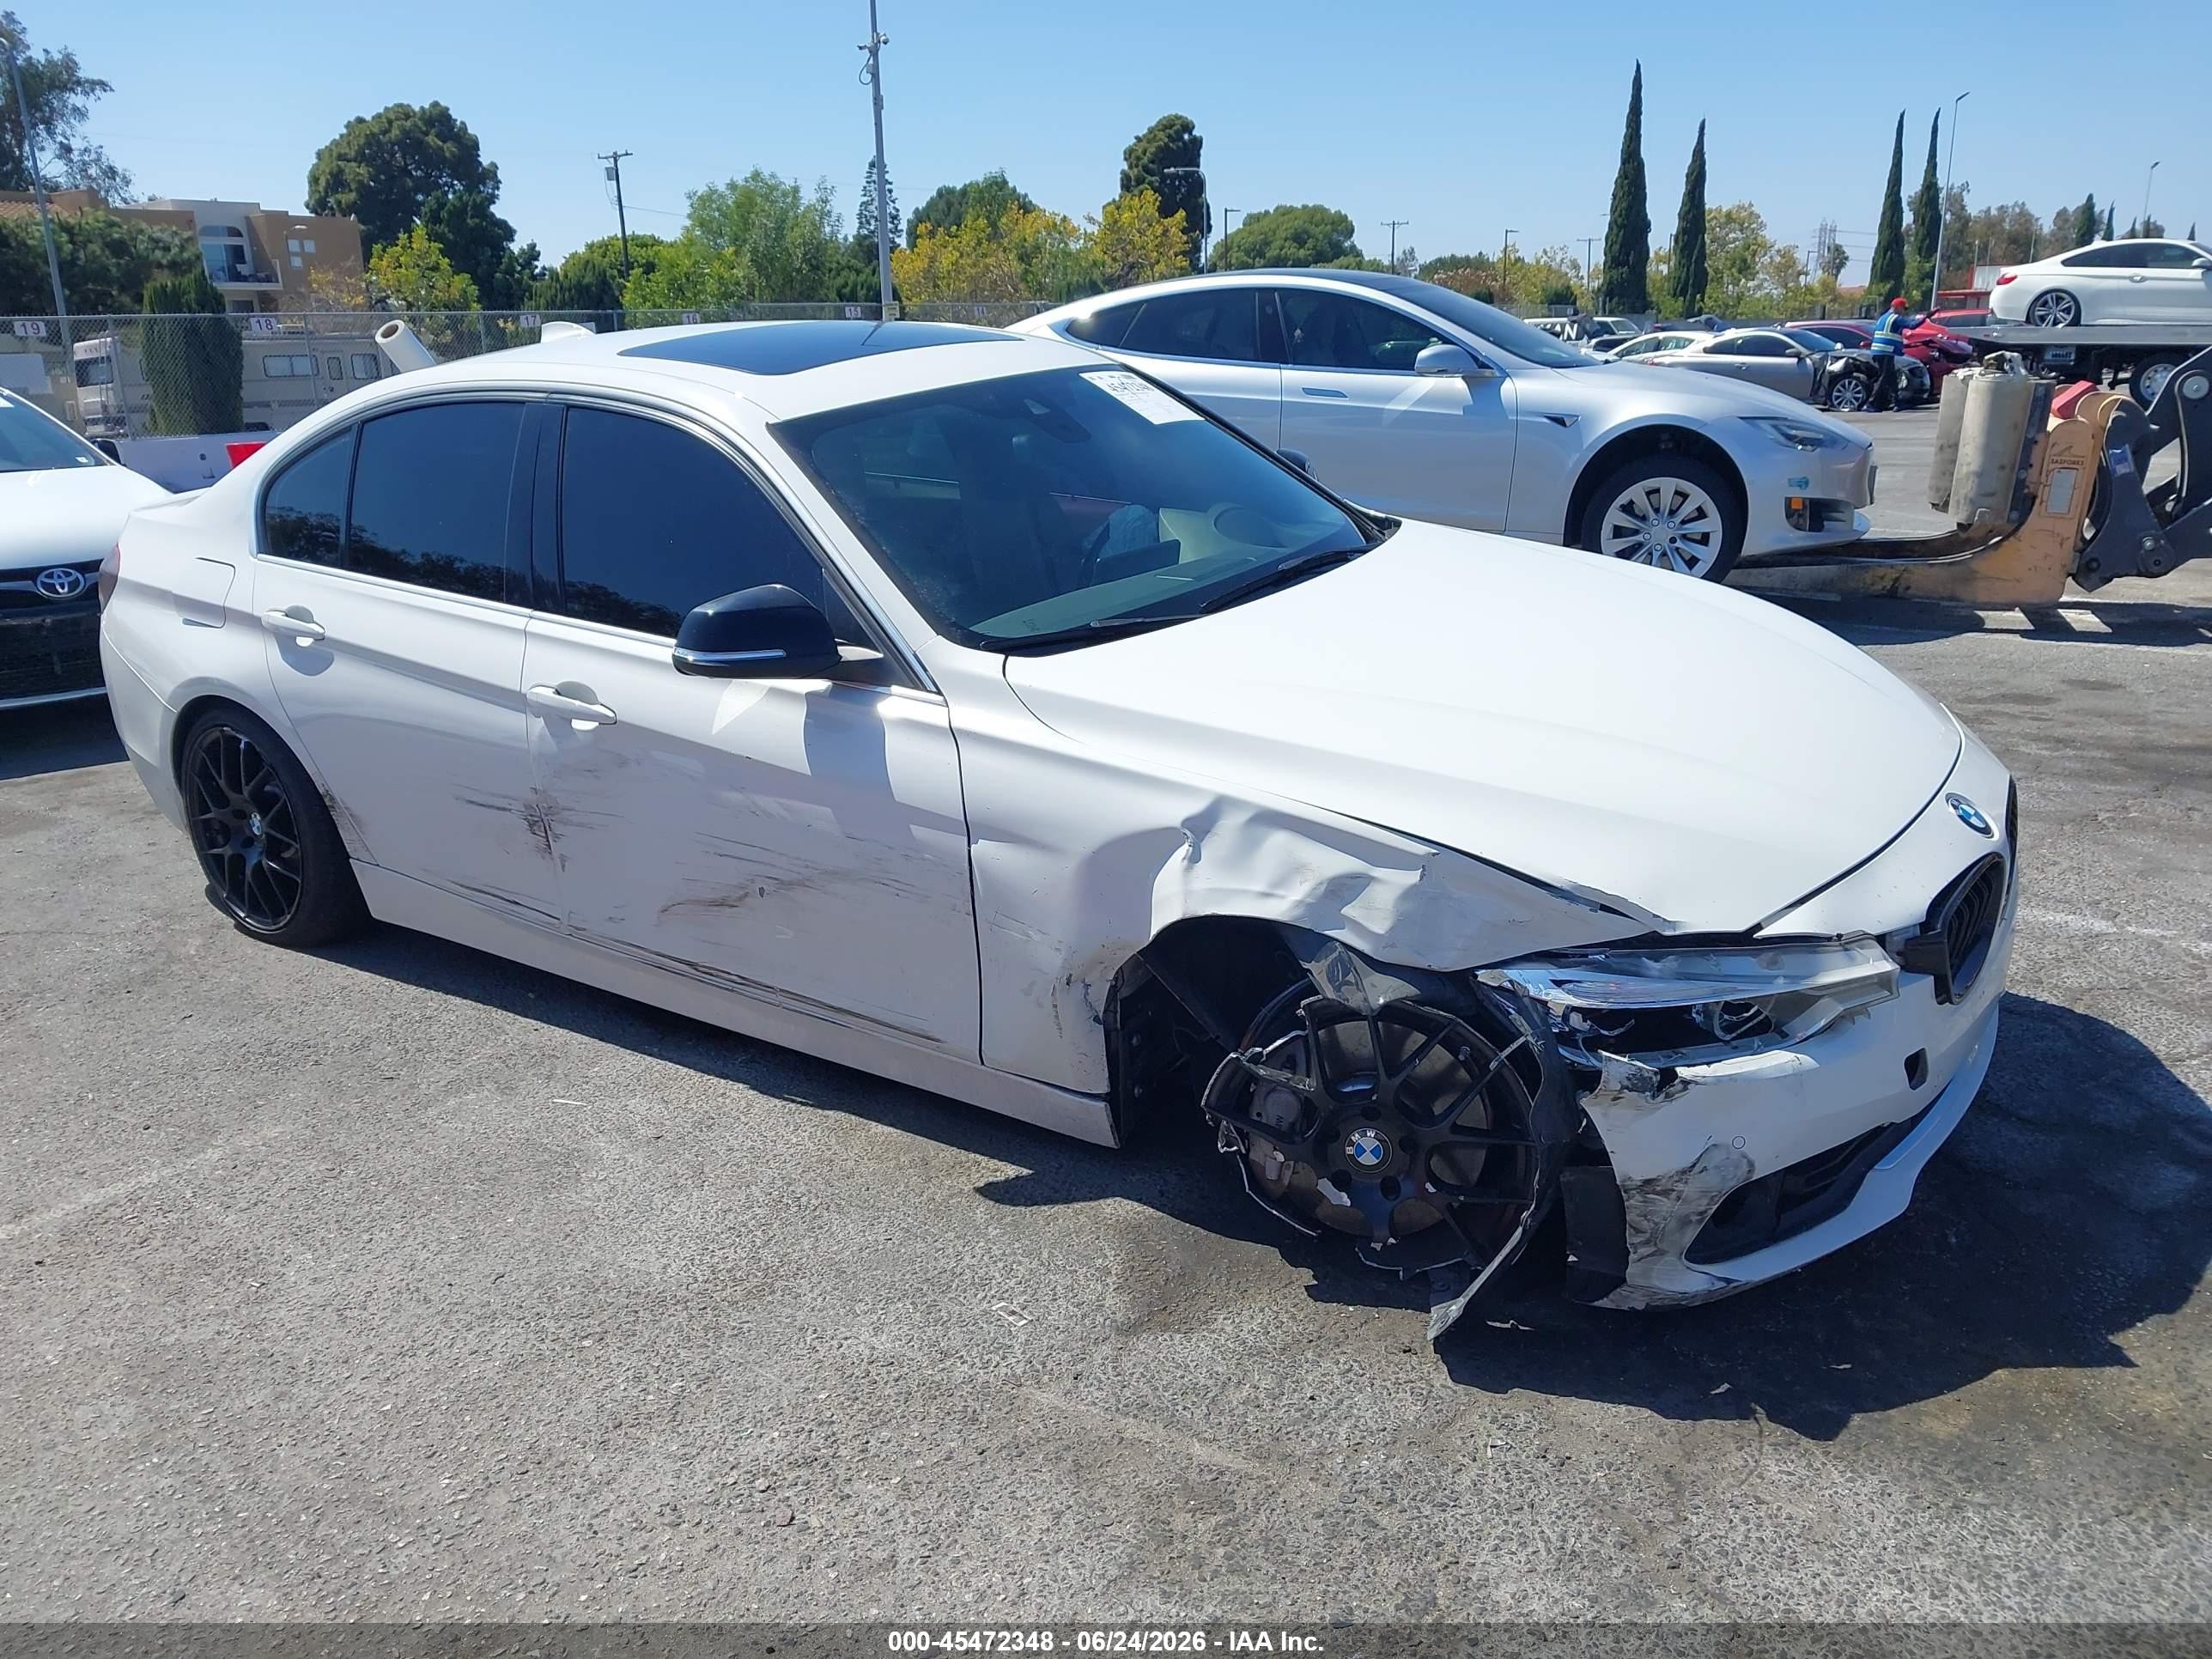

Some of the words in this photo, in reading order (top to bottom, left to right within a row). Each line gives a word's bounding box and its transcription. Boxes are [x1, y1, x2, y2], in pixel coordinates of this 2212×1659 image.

[848, 307, 859, 317] 15
[524, 315, 537, 326] 17
[687, 313, 697, 324] 16
[20, 321, 40, 335] 19
[255, 319, 273, 331] 18
